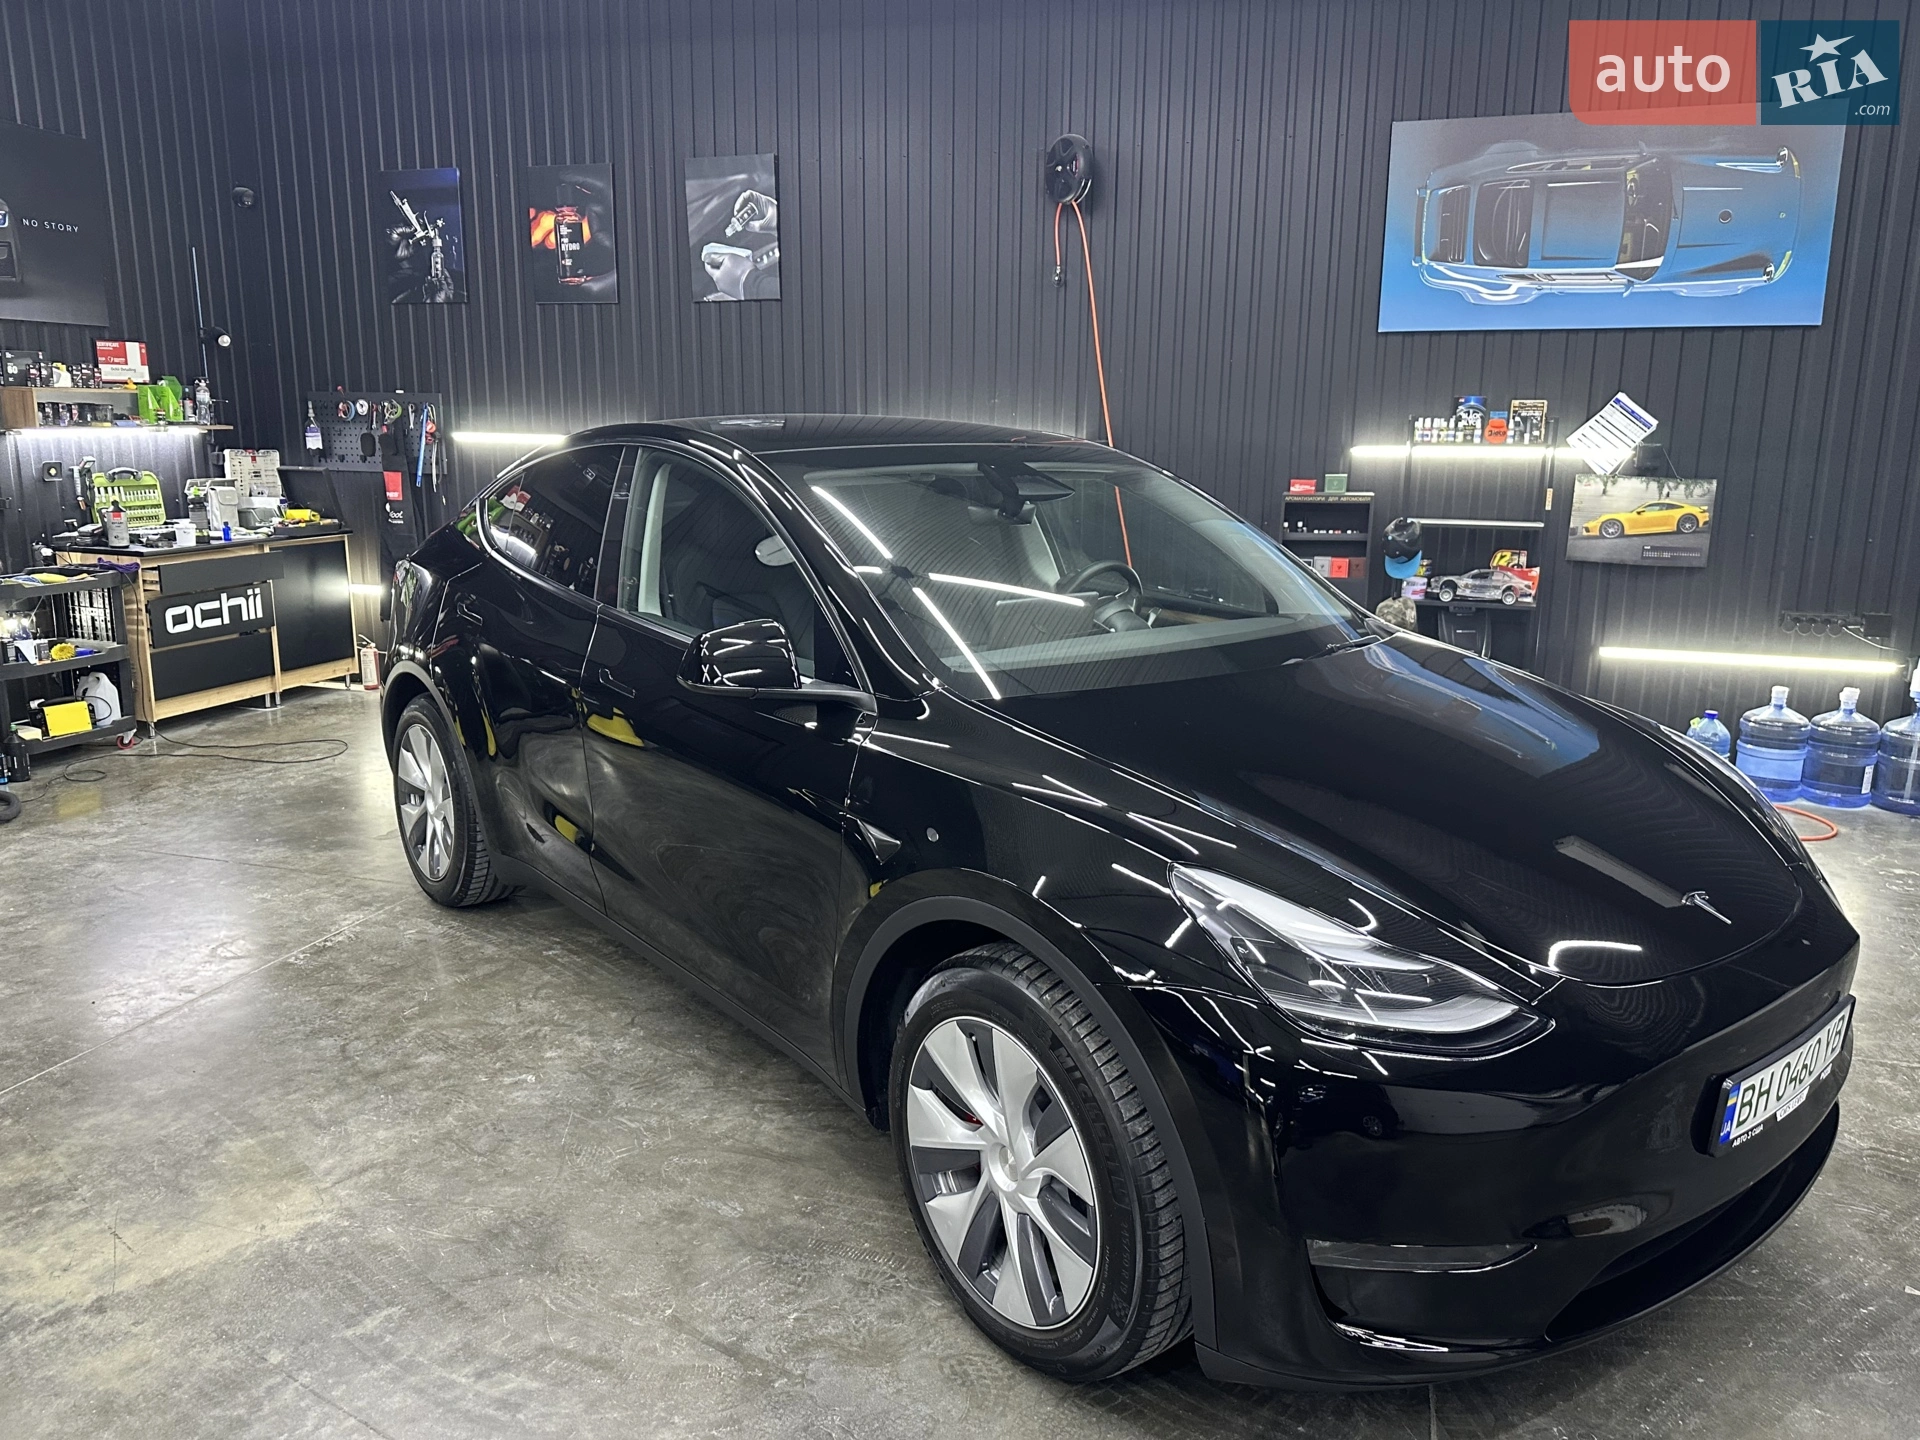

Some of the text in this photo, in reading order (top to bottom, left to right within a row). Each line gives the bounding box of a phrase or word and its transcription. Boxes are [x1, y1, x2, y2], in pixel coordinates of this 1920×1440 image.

[22, 218, 80, 233] NO STORY
[561, 243, 580, 251] HYDRO
[1492, 551, 1511, 566] 12
[165, 588, 263, 634] ochii
[1735, 1014, 1846, 1129] BH 0460 YB
